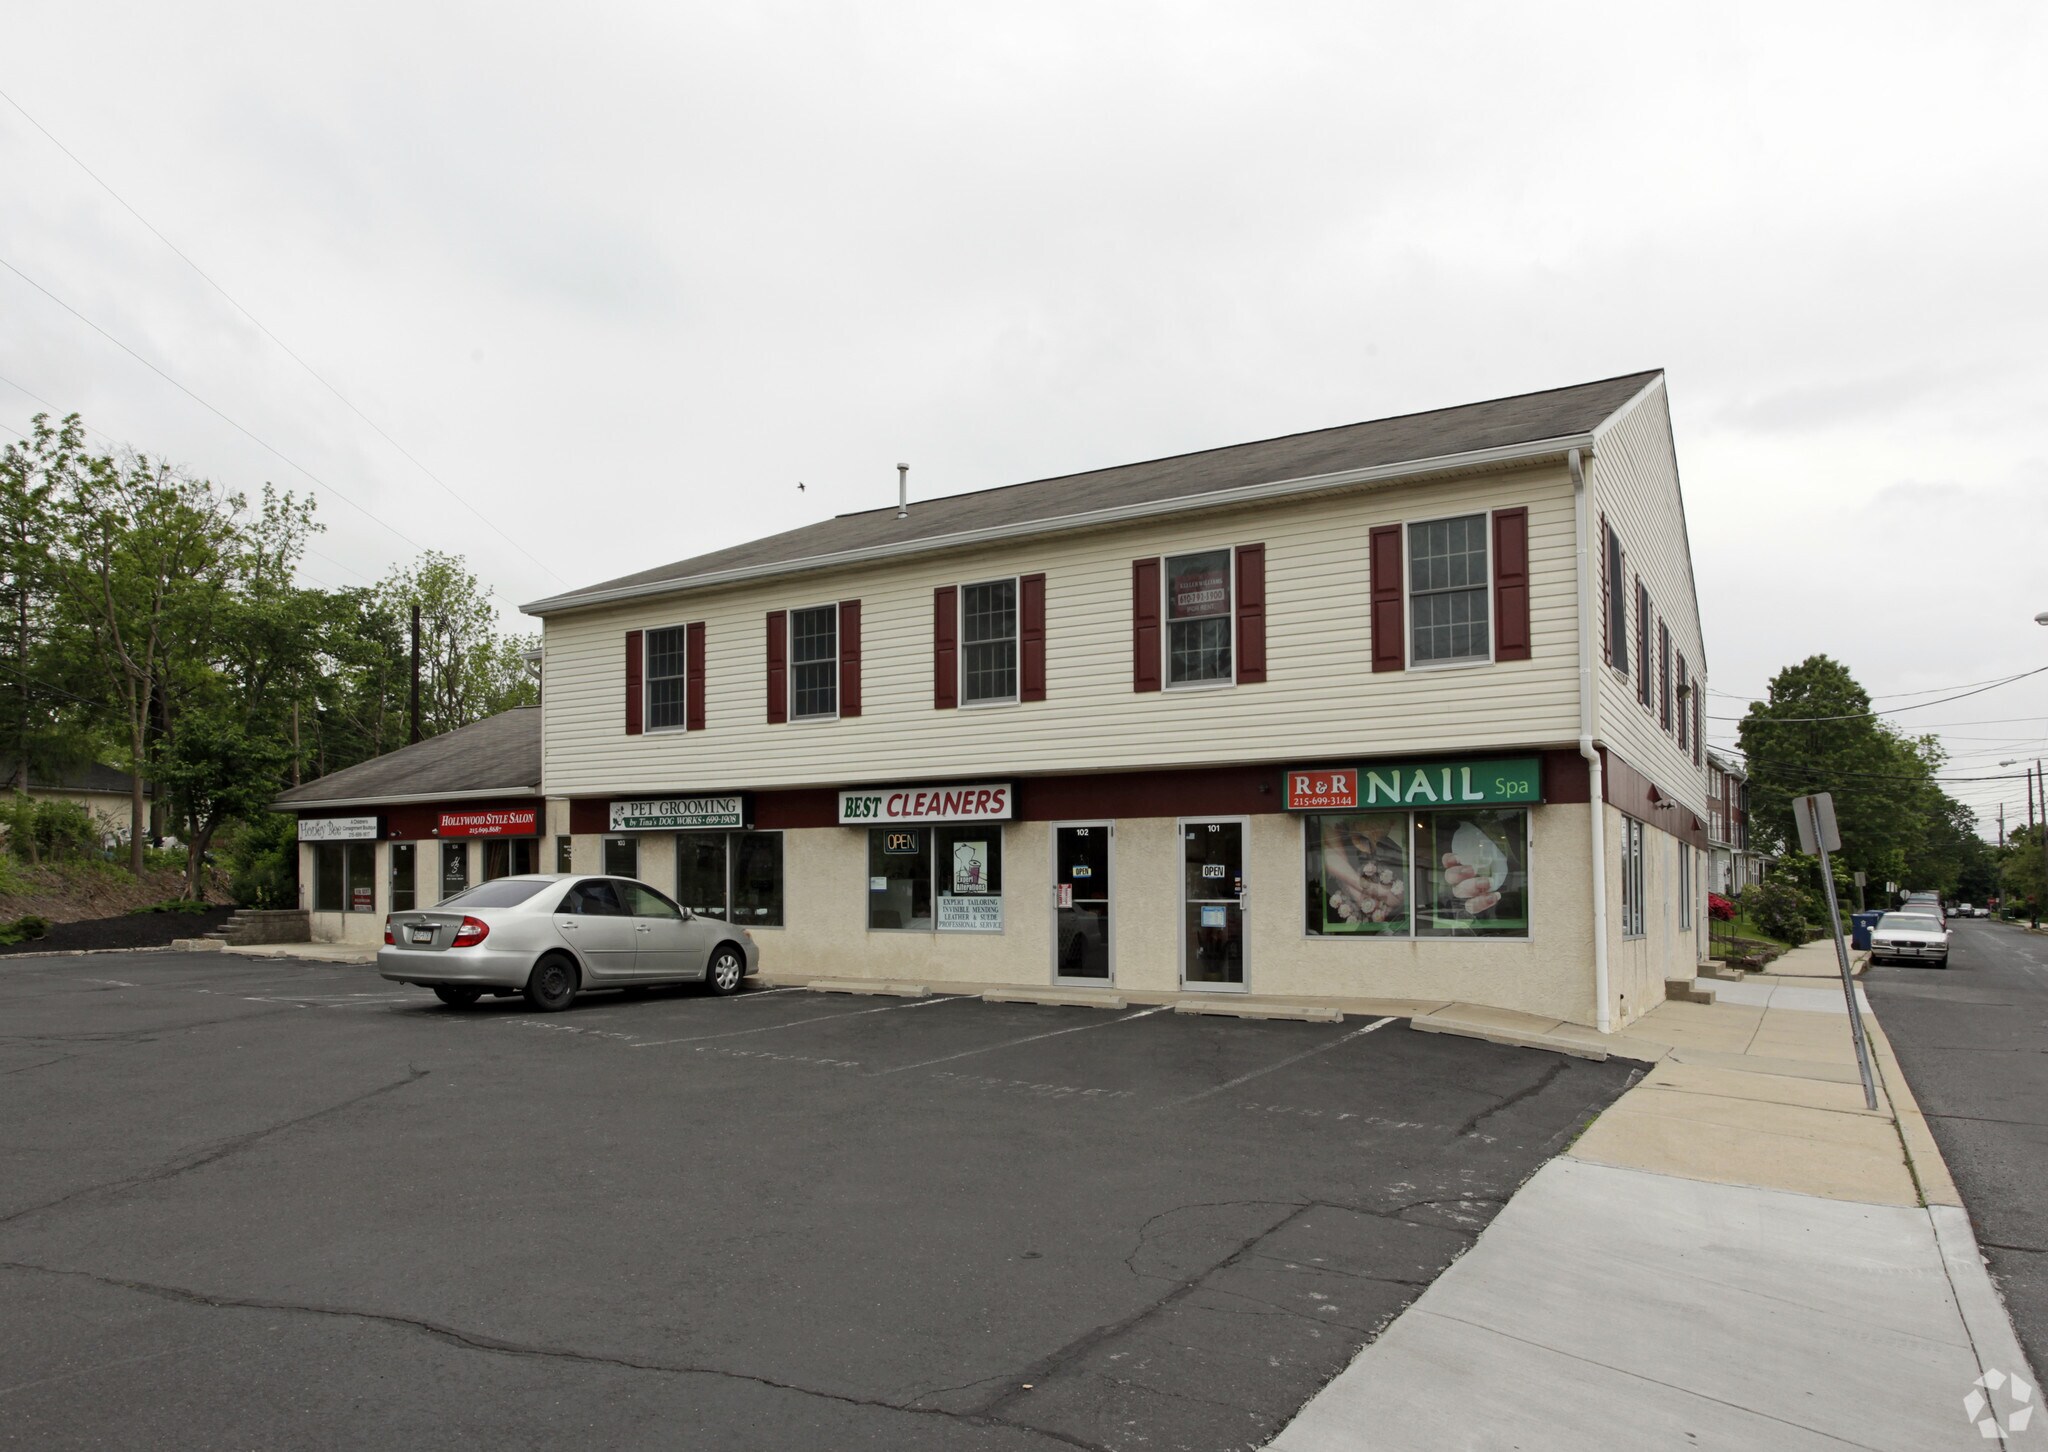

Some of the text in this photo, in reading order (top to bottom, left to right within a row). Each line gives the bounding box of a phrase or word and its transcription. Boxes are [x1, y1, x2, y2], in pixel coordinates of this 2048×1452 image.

[1295, 775, 1349, 794] R & R
[1367, 766, 1529, 803] NAIL Spa
[630, 799, 736, 816] PET GROOMING
[844, 789, 1006, 818] BEST CLEANERS
[1293, 796, 1352, 806] 215-699-3144
[441, 812, 534, 827] HOLLYWOOD STYLE SALON
[629, 815, 737, 828] by Tina's DOG WORKS 699-1908
[300, 820, 342, 840] Honey Bee
[887, 834, 915, 849] OPEN
[1075, 868, 1089, 876] OPEN
[1204, 866, 1224, 876] OPEN
